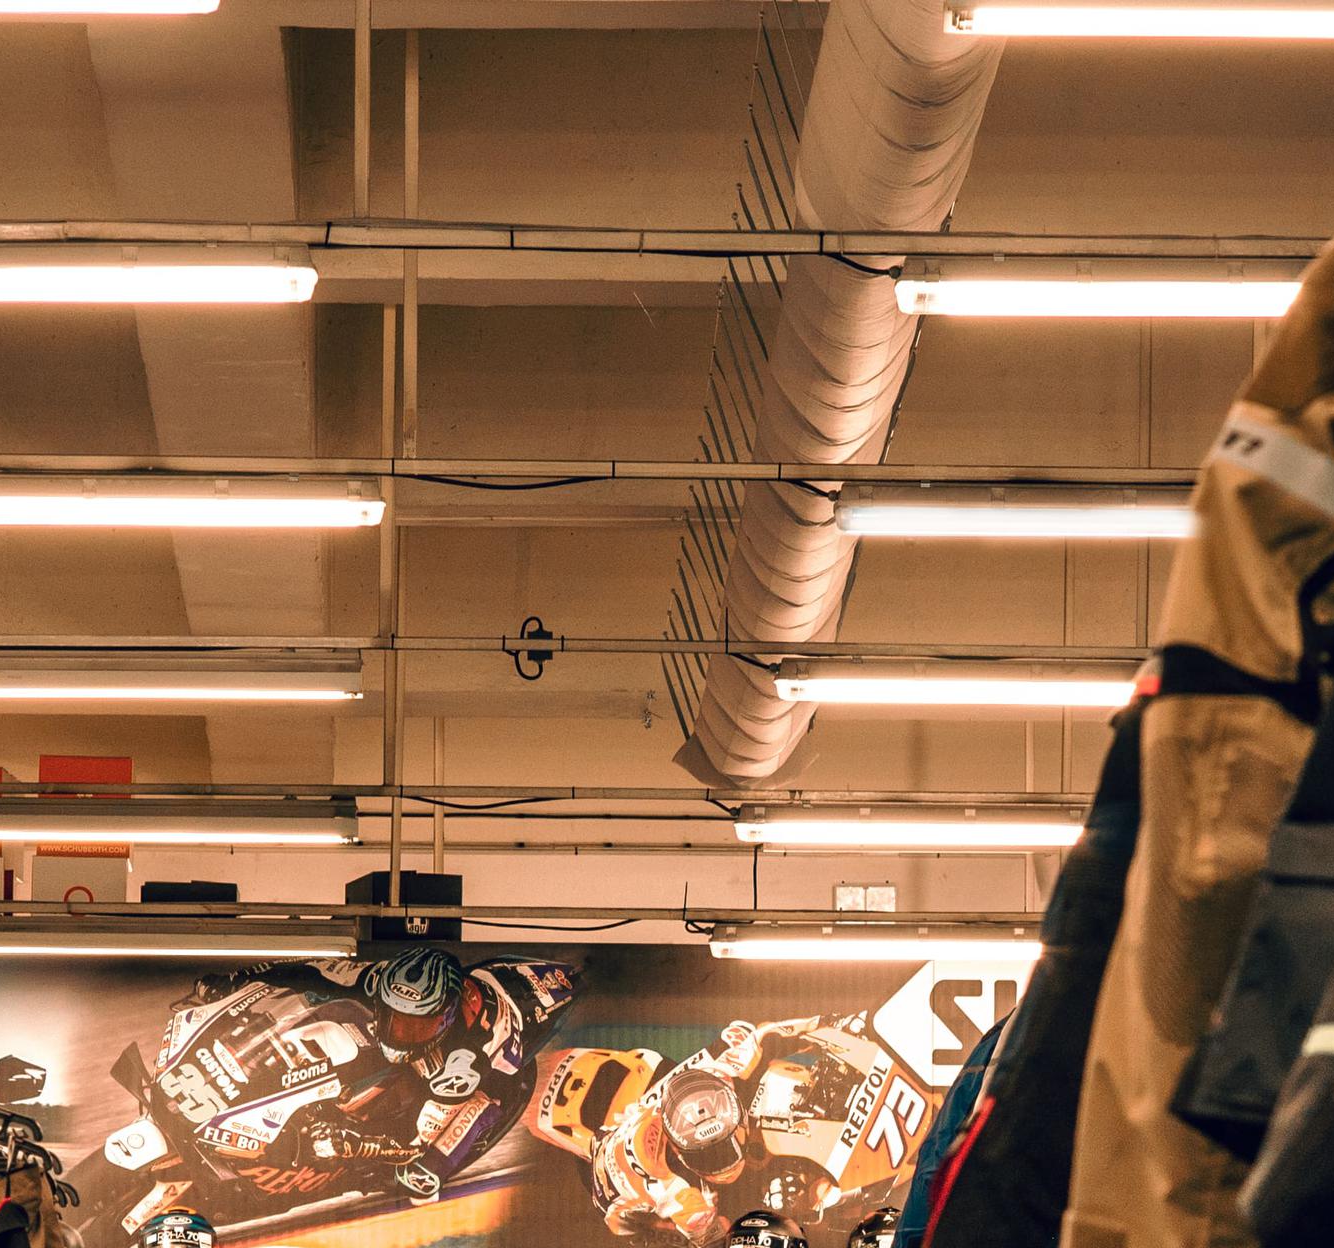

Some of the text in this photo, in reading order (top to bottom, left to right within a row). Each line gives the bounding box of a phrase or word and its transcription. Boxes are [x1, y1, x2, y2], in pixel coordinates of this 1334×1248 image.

[40, 845, 126, 854] WWW.SCHUBERTH.COM
[391, 983, 421, 1001] HJC
[195, 1047, 241, 1101] CUSTOM
[281, 1062, 329, 1090] rizoma
[540, 1054, 575, 1119] REPSOL
[841, 1065, 888, 1149] REPSOL
[230, 1121, 272, 1141] SENA
[441, 1098, 486, 1153] HONDA
[699, 1123, 722, 1138] SHOEI
[865, 1074, 927, 1170] 73
[187, 1231, 199, 1240] 70
